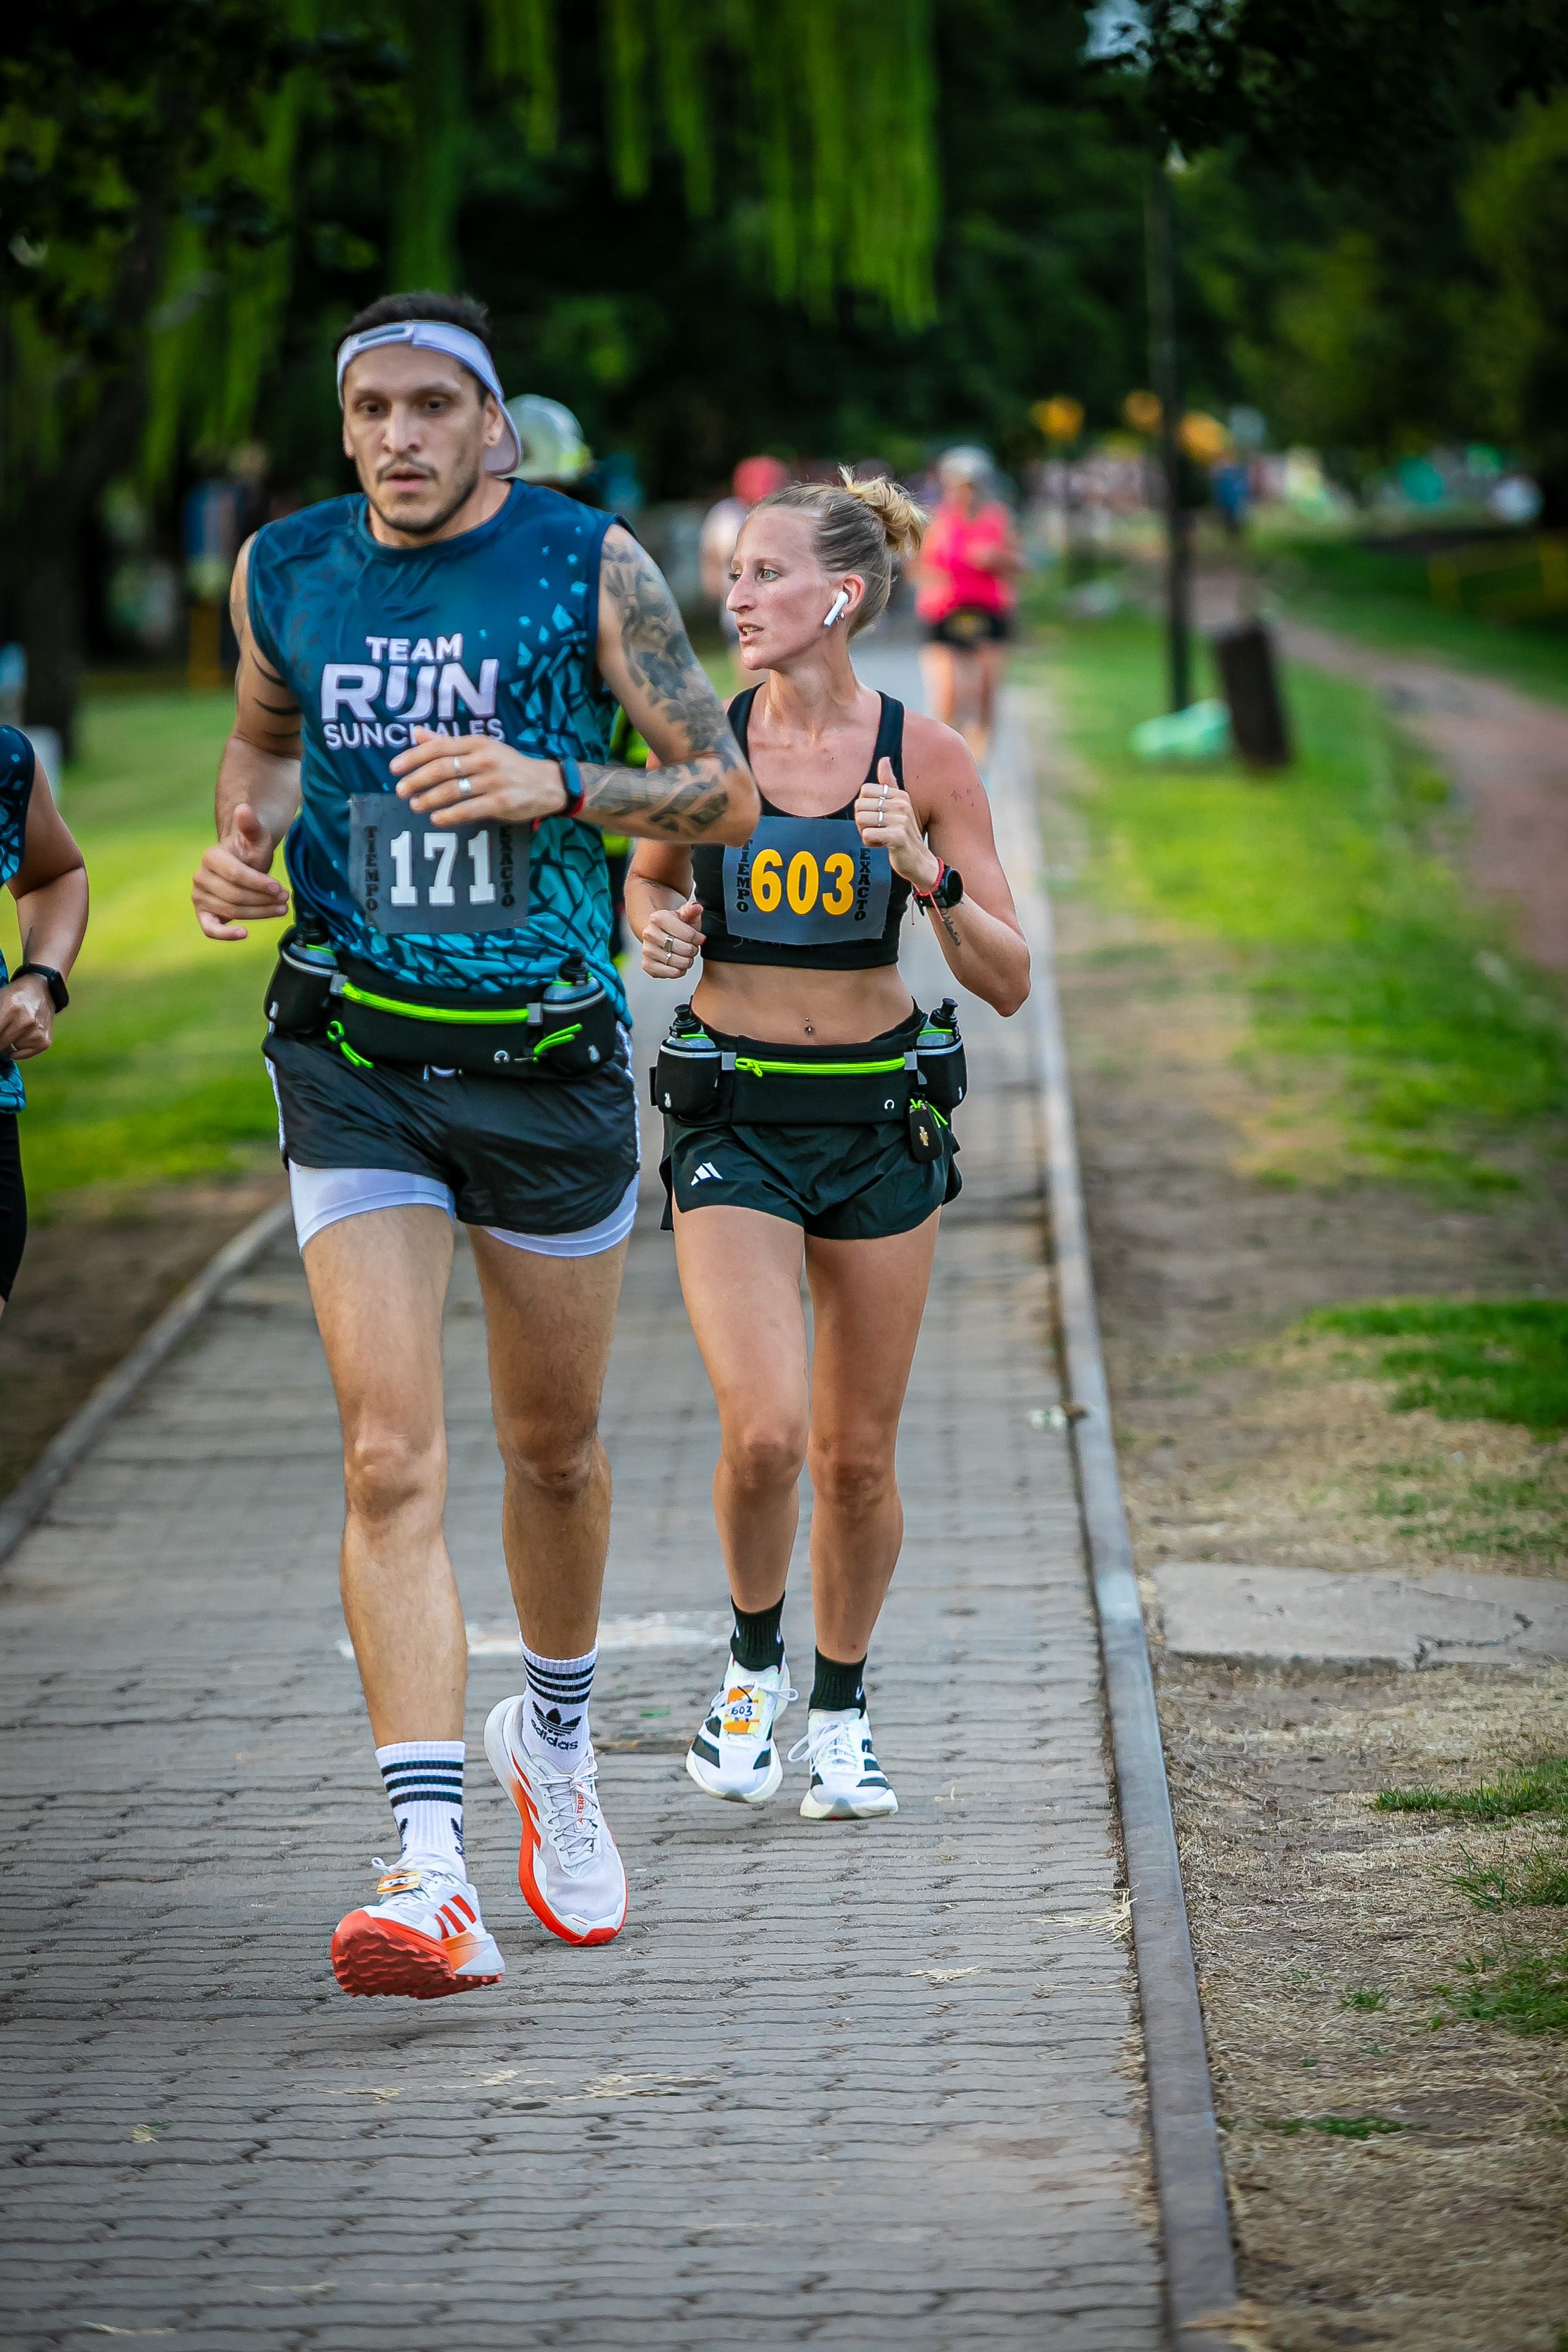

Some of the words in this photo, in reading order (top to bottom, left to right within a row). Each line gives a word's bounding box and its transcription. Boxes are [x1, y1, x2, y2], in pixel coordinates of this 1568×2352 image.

[364, 633, 464, 663] TEAM
[321, 659, 499, 723] RUN
[364, 825, 380, 911] TIEMPO
[390, 830, 496, 906] 171
[736, 839, 753, 913] TIEMPO
[751, 848, 855, 915] 603
[853, 848, 872, 921] EXACTO
[530, 1718, 579, 1750] adidas
[731, 1705, 753, 1717] 603
